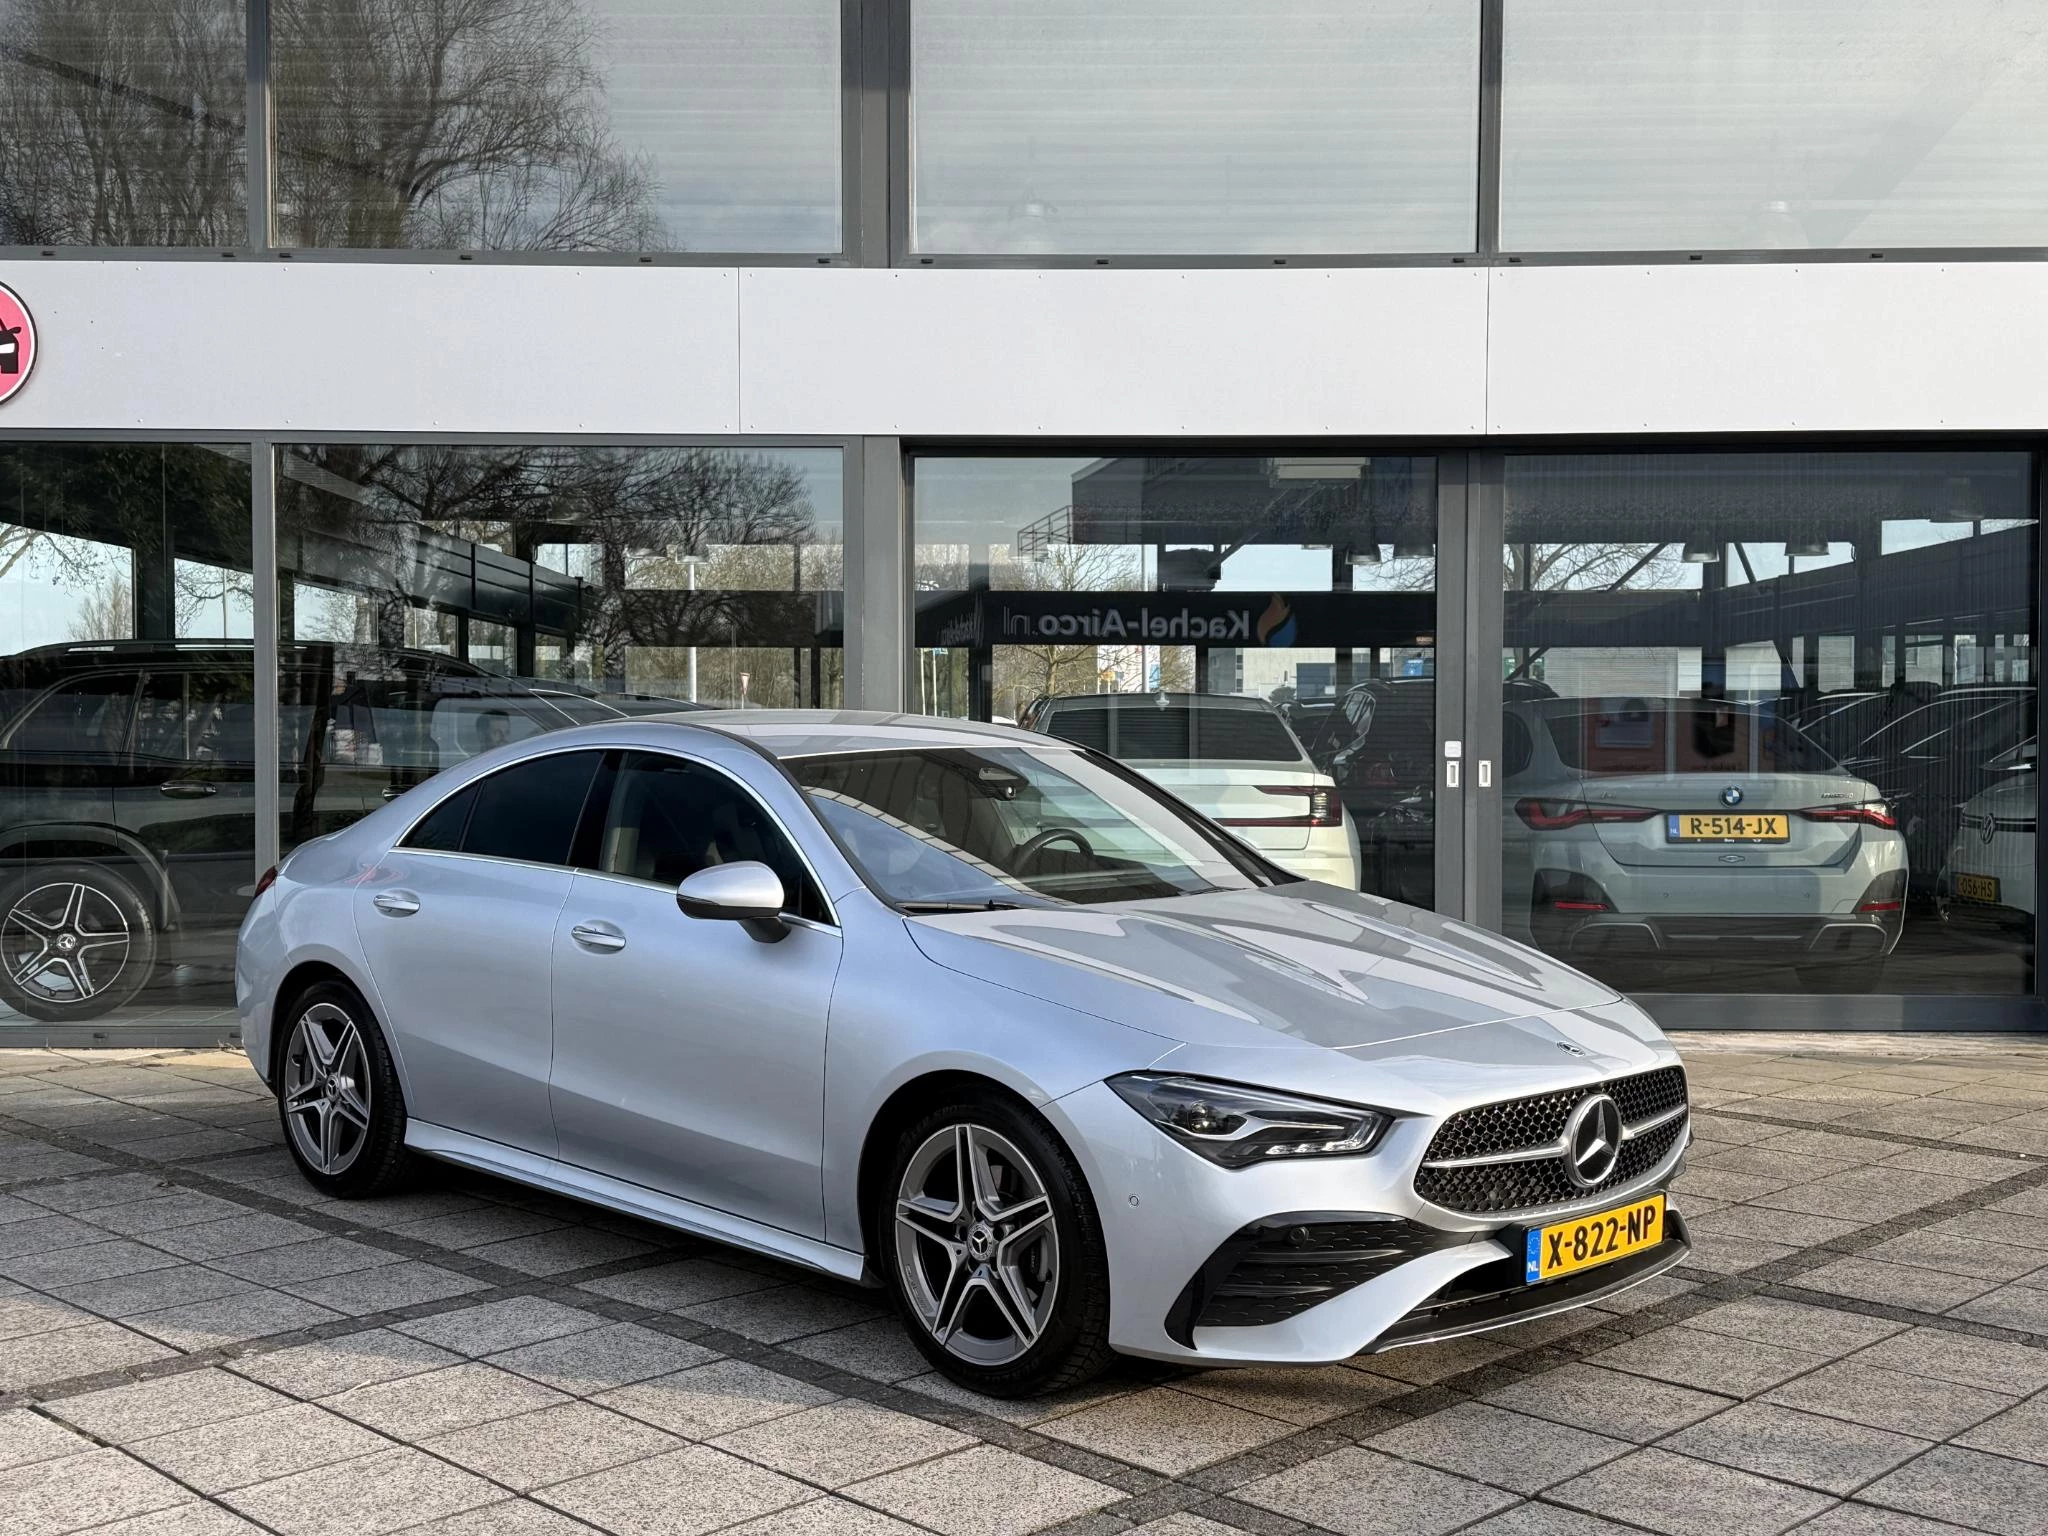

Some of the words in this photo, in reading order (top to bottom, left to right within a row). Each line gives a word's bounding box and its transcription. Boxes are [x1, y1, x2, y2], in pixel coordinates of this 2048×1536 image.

[1690, 817, 1777, 835] R-514-JX
[1957, 877, 1993, 898] -056-HS
[1527, 1261, 1539, 1273] NL
[1547, 1204, 1657, 1270] X-822-NP
